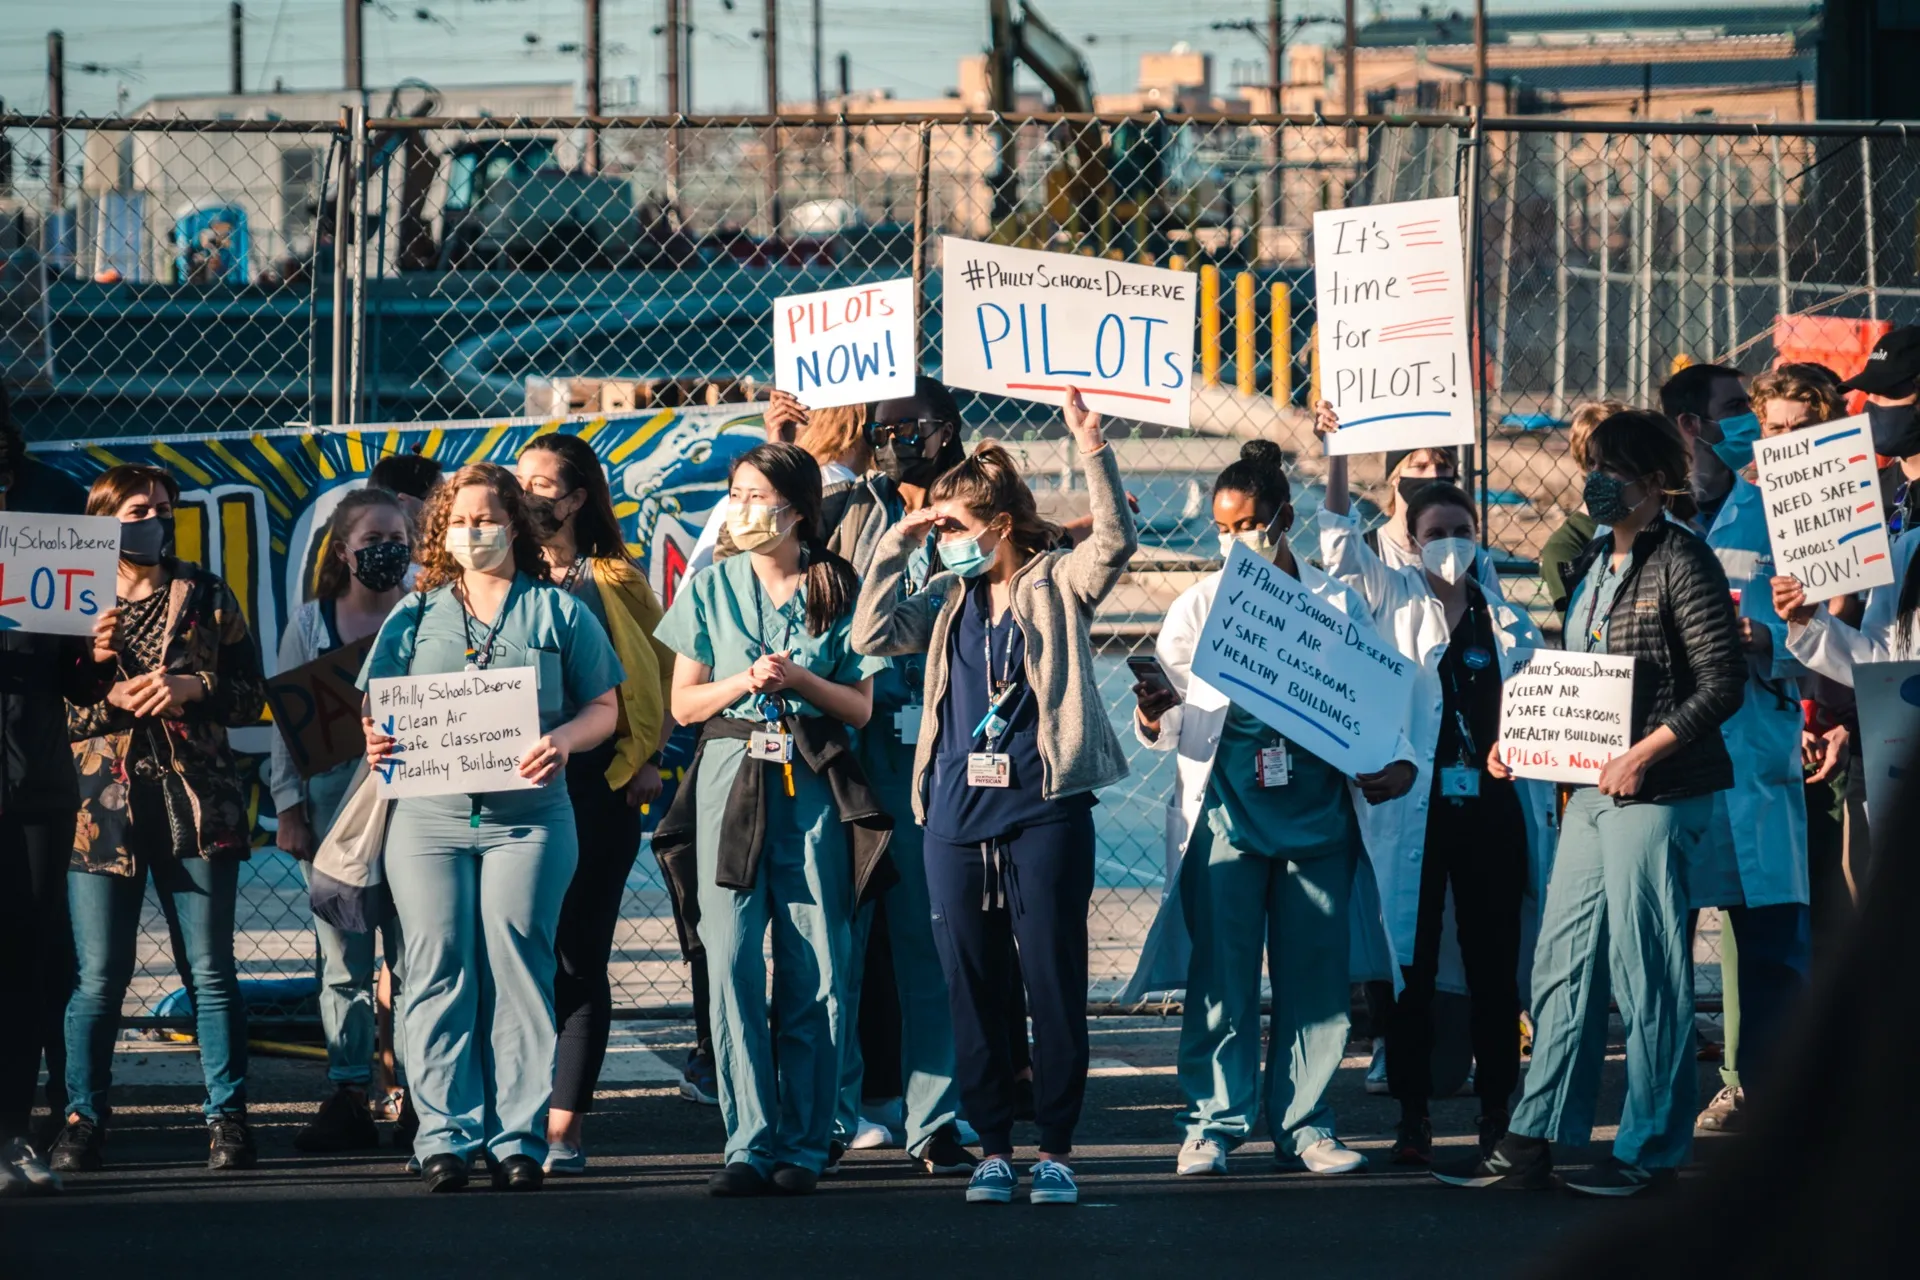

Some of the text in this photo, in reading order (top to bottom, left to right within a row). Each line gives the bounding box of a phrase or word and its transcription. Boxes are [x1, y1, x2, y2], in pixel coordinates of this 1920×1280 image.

[1332, 219, 1390, 255] It's
[1327, 271, 1400, 306] time
[1333, 320, 1371, 350] for
[796, 330, 896, 392] NOW!
[1762, 438, 1809, 465] PHILLY
[1766, 458, 1846, 491] STUDENTS
[1772, 480, 1858, 517] NEED SAFE
[1794, 506, 1852, 536] HEALTHY
[1783, 539, 1835, 563] SCHOOLS
[1242, 600, 1322, 652] CLEAN AIR
[1235, 624, 1357, 703] SAFE CLASSROOMS
[1224, 644, 1361, 736] HEALTHY BUILDINGS
[1517, 684, 1580, 698] CLEAN AIR
[398, 709, 467, 731] Clean Air
[1518, 705, 1621, 724] SAFE CLASSROOMS
[397, 727, 521, 751] Safe Classrooms
[1512, 726, 1623, 747] HEALTHY BUILDINGS
[398, 751, 521, 781] Healthy Buildings
